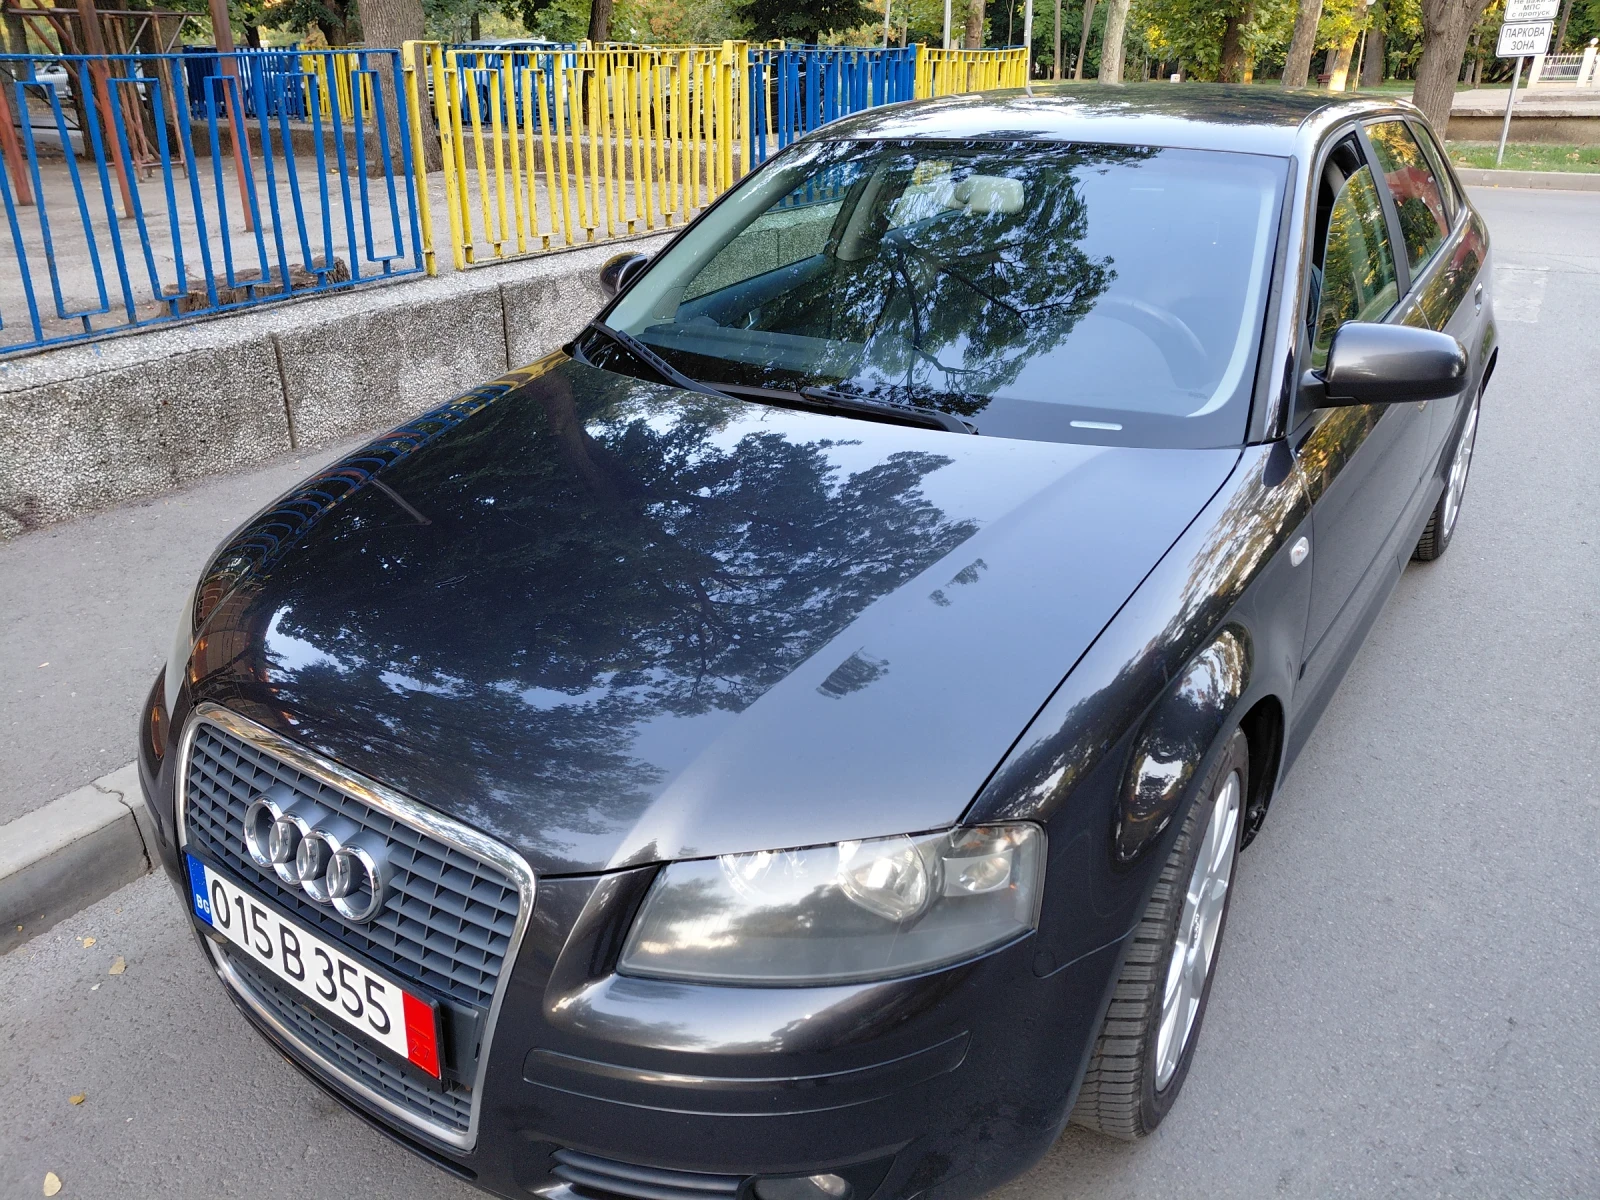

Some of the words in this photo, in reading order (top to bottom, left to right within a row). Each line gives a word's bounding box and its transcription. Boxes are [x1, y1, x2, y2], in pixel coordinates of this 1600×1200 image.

[1505, 27, 1545, 38] ПАРКОВА
[1510, 40, 1535, 50] ЗОНА
[195, 893, 210, 914] BG
